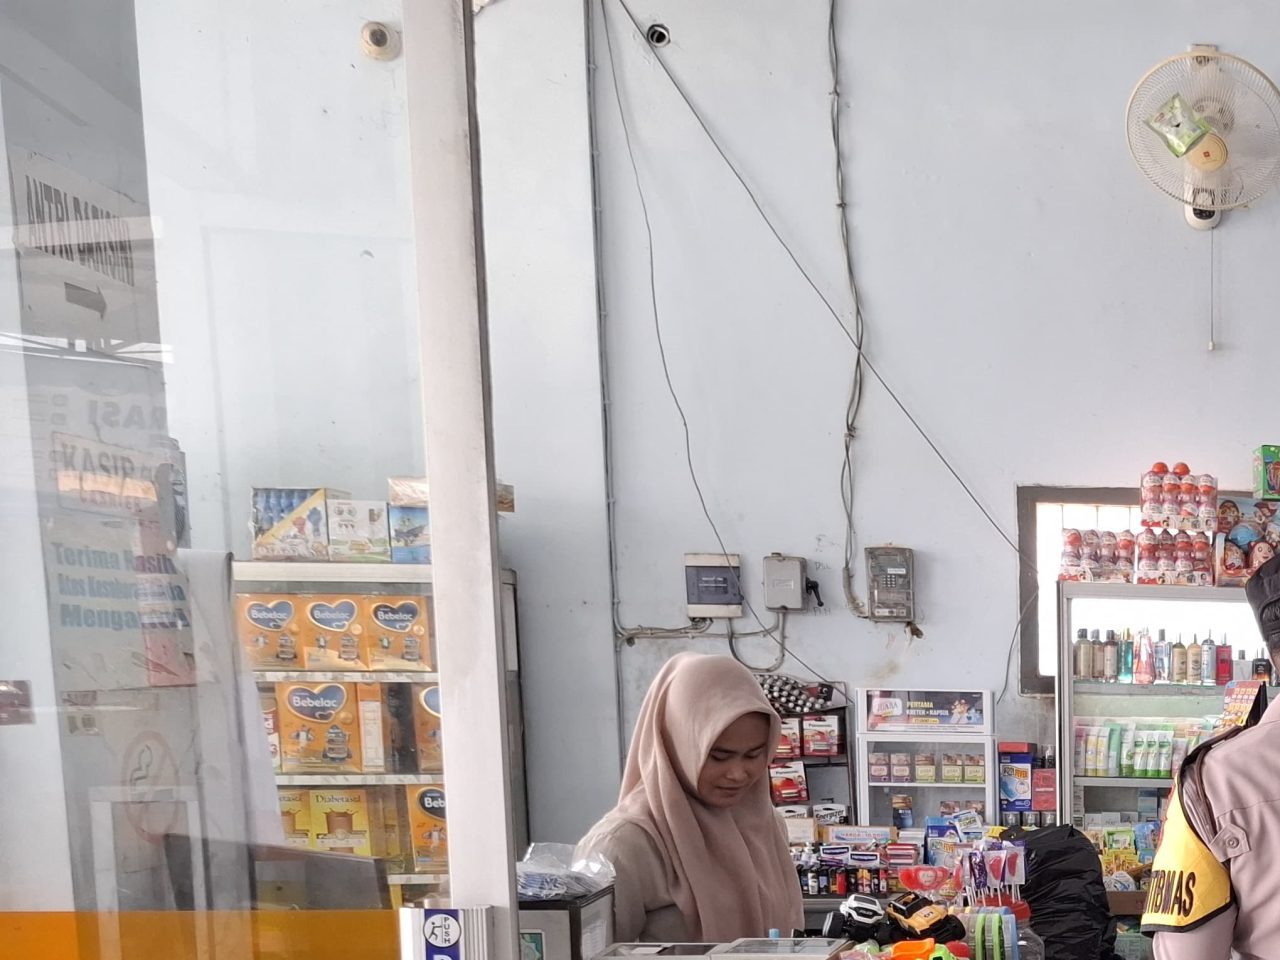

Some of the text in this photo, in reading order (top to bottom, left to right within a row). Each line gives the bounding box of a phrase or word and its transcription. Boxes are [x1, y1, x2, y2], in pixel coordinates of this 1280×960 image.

[250, 609, 288, 620] Bebelac
[313, 609, 350, 620] Bebelac
[377, 610, 414, 621] Bebelac
[292, 696, 338, 708] Bebelac
[815, 809, 845, 821] Energizer
[443, 916, 451, 944] PUSH
